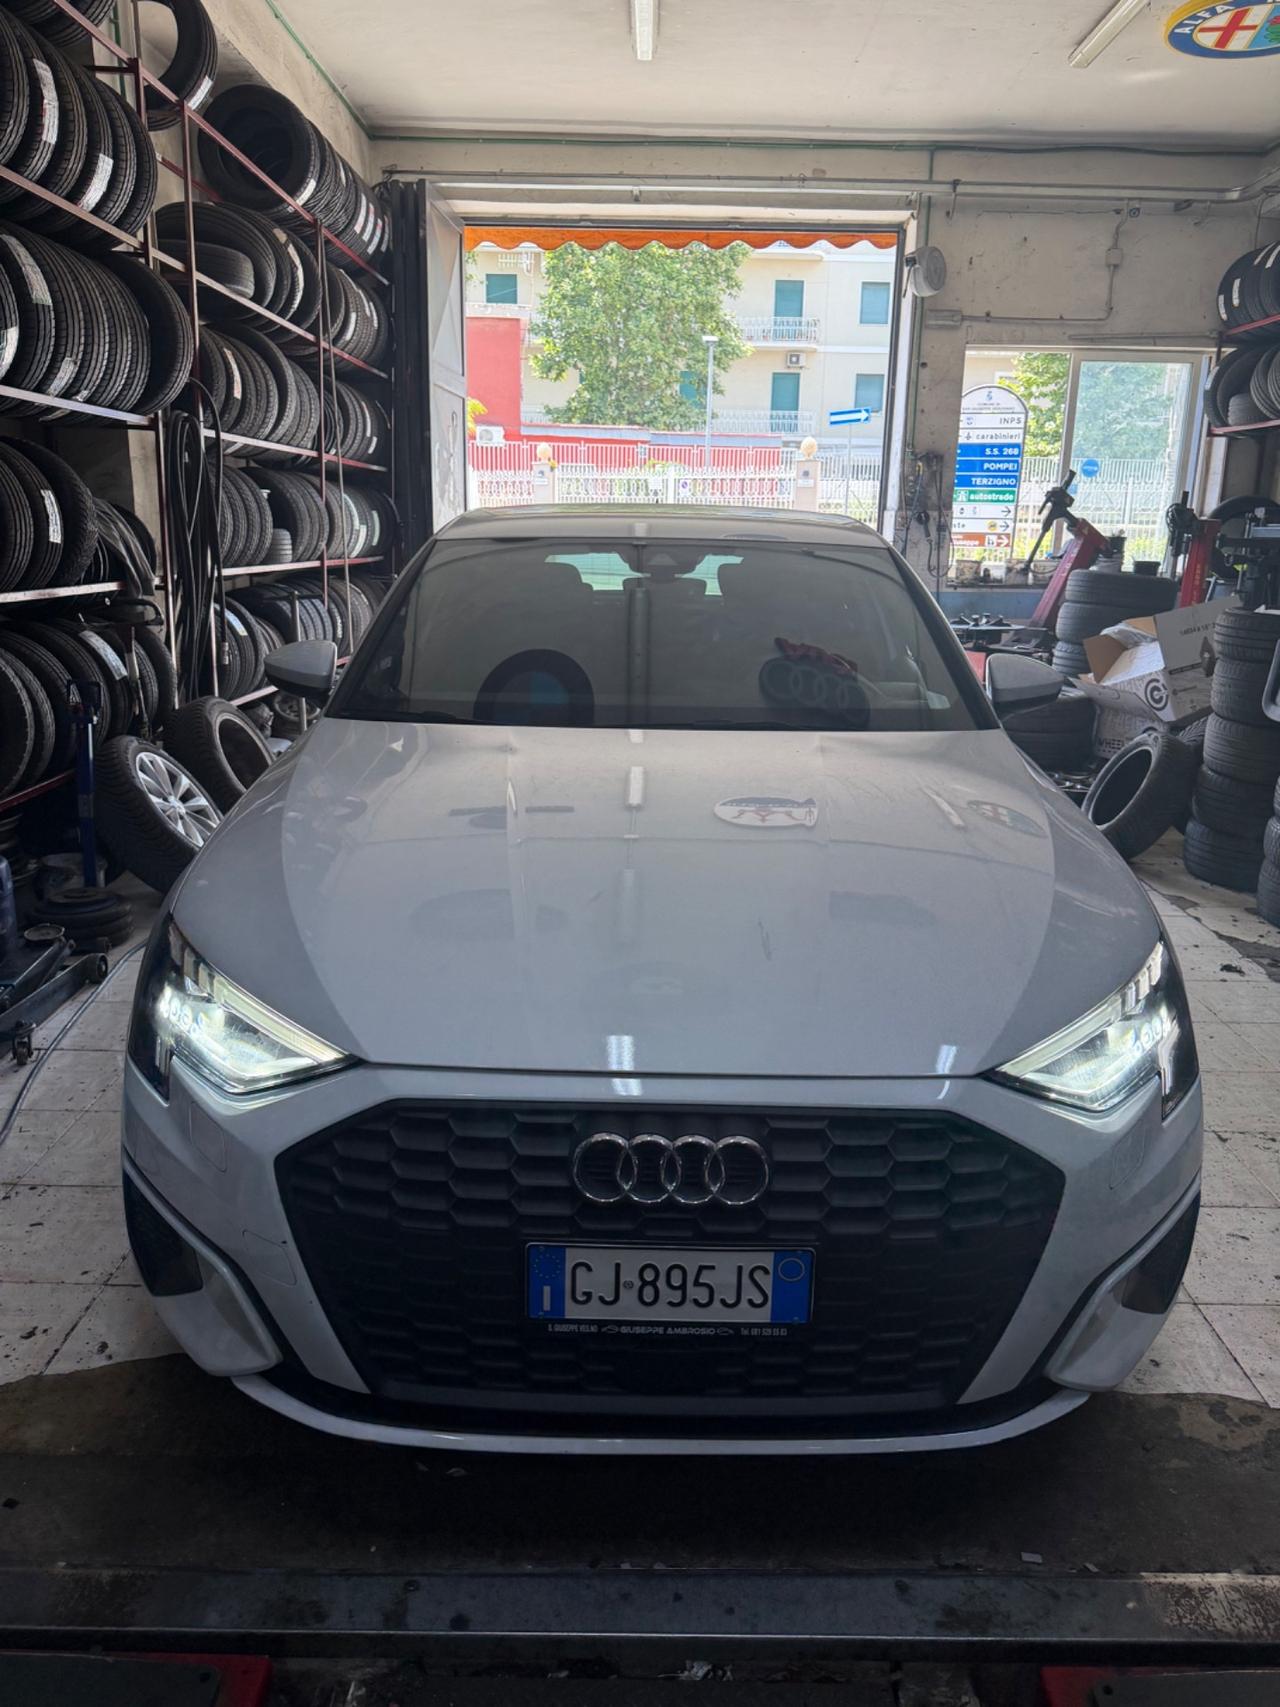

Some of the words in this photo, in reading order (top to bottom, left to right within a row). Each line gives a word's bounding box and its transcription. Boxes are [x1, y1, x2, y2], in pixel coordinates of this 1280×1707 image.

[1173, 5, 1236, 34] ALFA
[1000, 417, 1022, 425] INPS
[976, 432, 1021, 441] carabinieri
[985, 447, 1000, 456] S.S.
[1002, 448, 1019, 456] 268
[983, 462, 1018, 471] POMPEI
[971, 477, 1016, 486] TERZIGNO
[969, 492, 1014, 501] autostrade
[620, 1325, 664, 1335] GIUSEPPE
[666, 1326, 716, 1336] AMBROSIO
